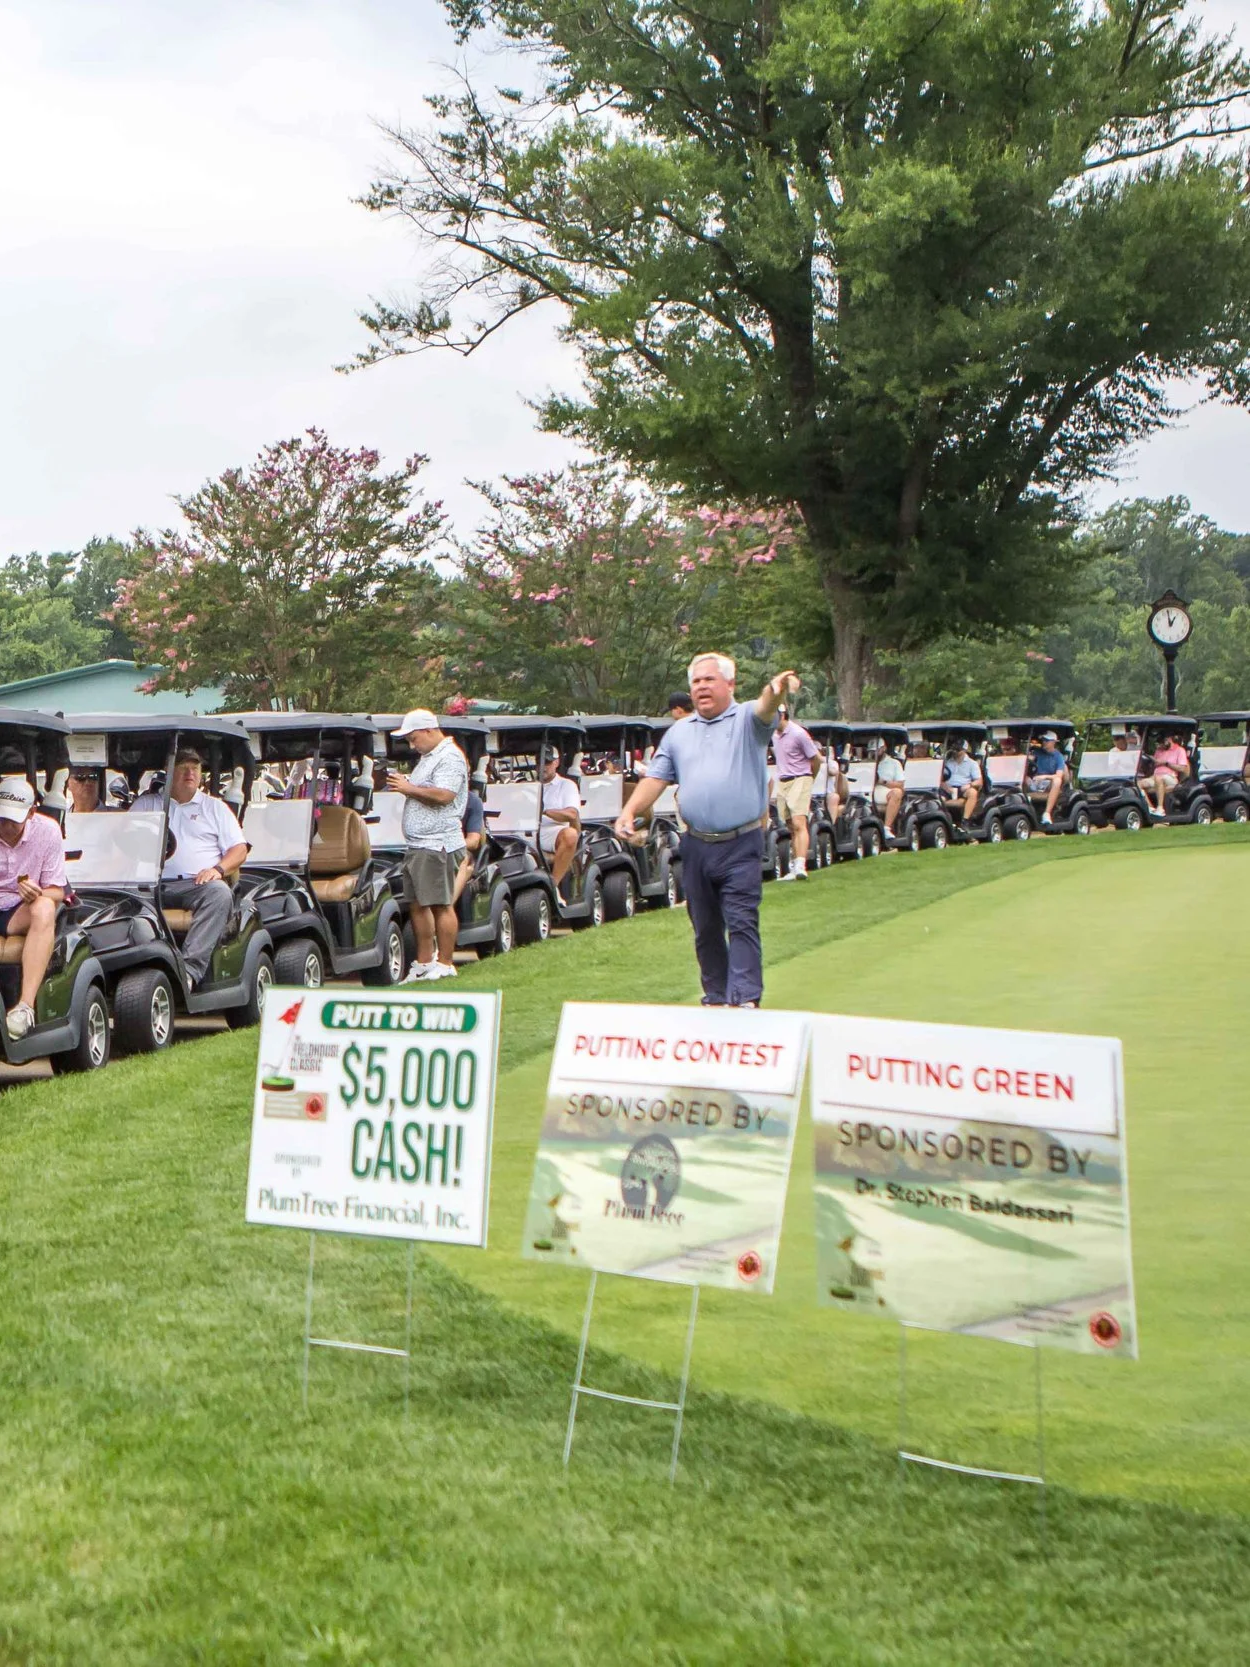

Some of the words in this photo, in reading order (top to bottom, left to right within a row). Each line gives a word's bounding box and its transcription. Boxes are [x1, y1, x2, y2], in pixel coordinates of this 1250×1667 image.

[331, 1004, 386, 1027] PUTT
[388, 1005, 417, 1029] TO
[421, 1006, 465, 1031] WIN
[573, 1035, 667, 1061] PUTTING
[673, 1039, 785, 1068] CONTEST
[339, 1041, 477, 1116] $5,000
[846, 1054, 964, 1090] PUTTING
[972, 1065, 1075, 1102] GREEN
[565, 1093, 722, 1126] SPONSORED
[733, 1105, 771, 1131] BY
[351, 1118, 464, 1187] CASH!
[837, 1120, 1033, 1169] SPONSORED
[1048, 1143, 1092, 1176] BY
[344, 1196, 429, 1231] Financial,
[435, 1204, 470, 1231] Inc.
[886, 1181, 964, 1211] Stephen
